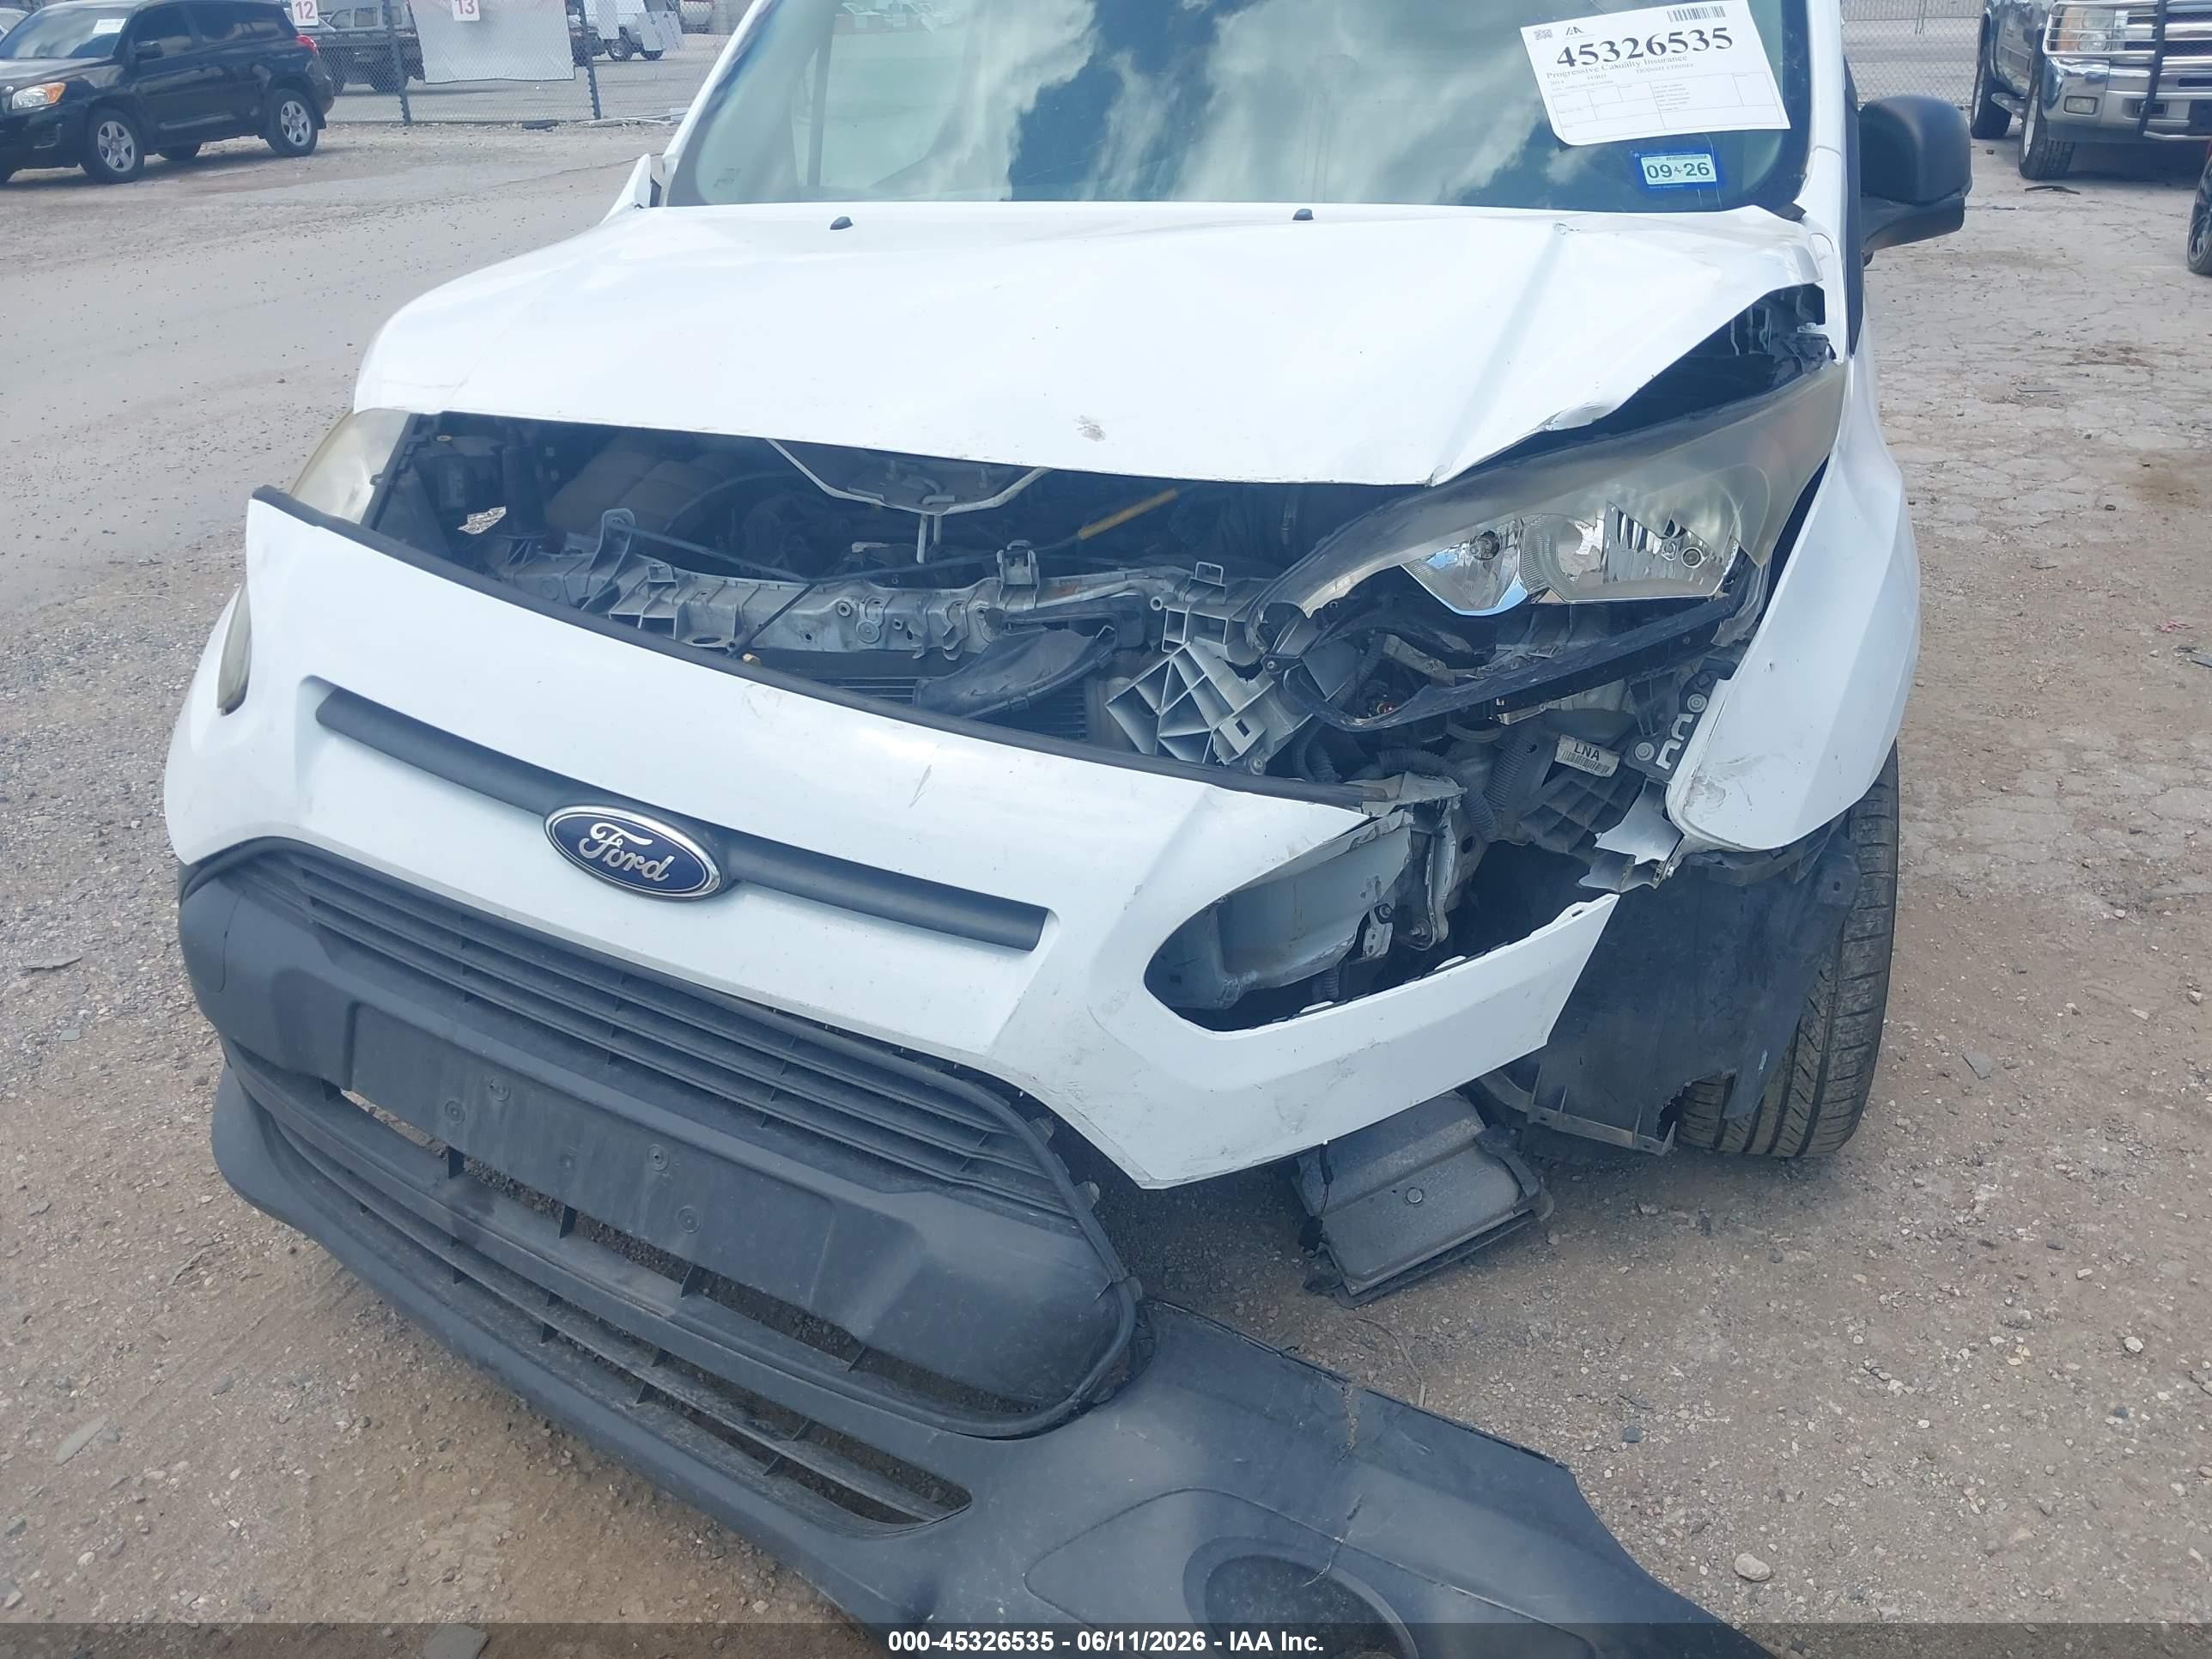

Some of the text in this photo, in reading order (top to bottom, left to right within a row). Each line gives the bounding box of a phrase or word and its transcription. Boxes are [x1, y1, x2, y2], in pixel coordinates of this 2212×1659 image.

[295, 1, 316, 21] 12
[456, 0, 475, 15] 13
[1555, 27, 1733, 67] 45326535
[1546, 55, 1688, 79] Progressive Casualty Insurance
[1646, 162, 1710, 179] 09 26
[1573, 742, 1601, 762] LNA
[578, 822, 676, 882] Ford
